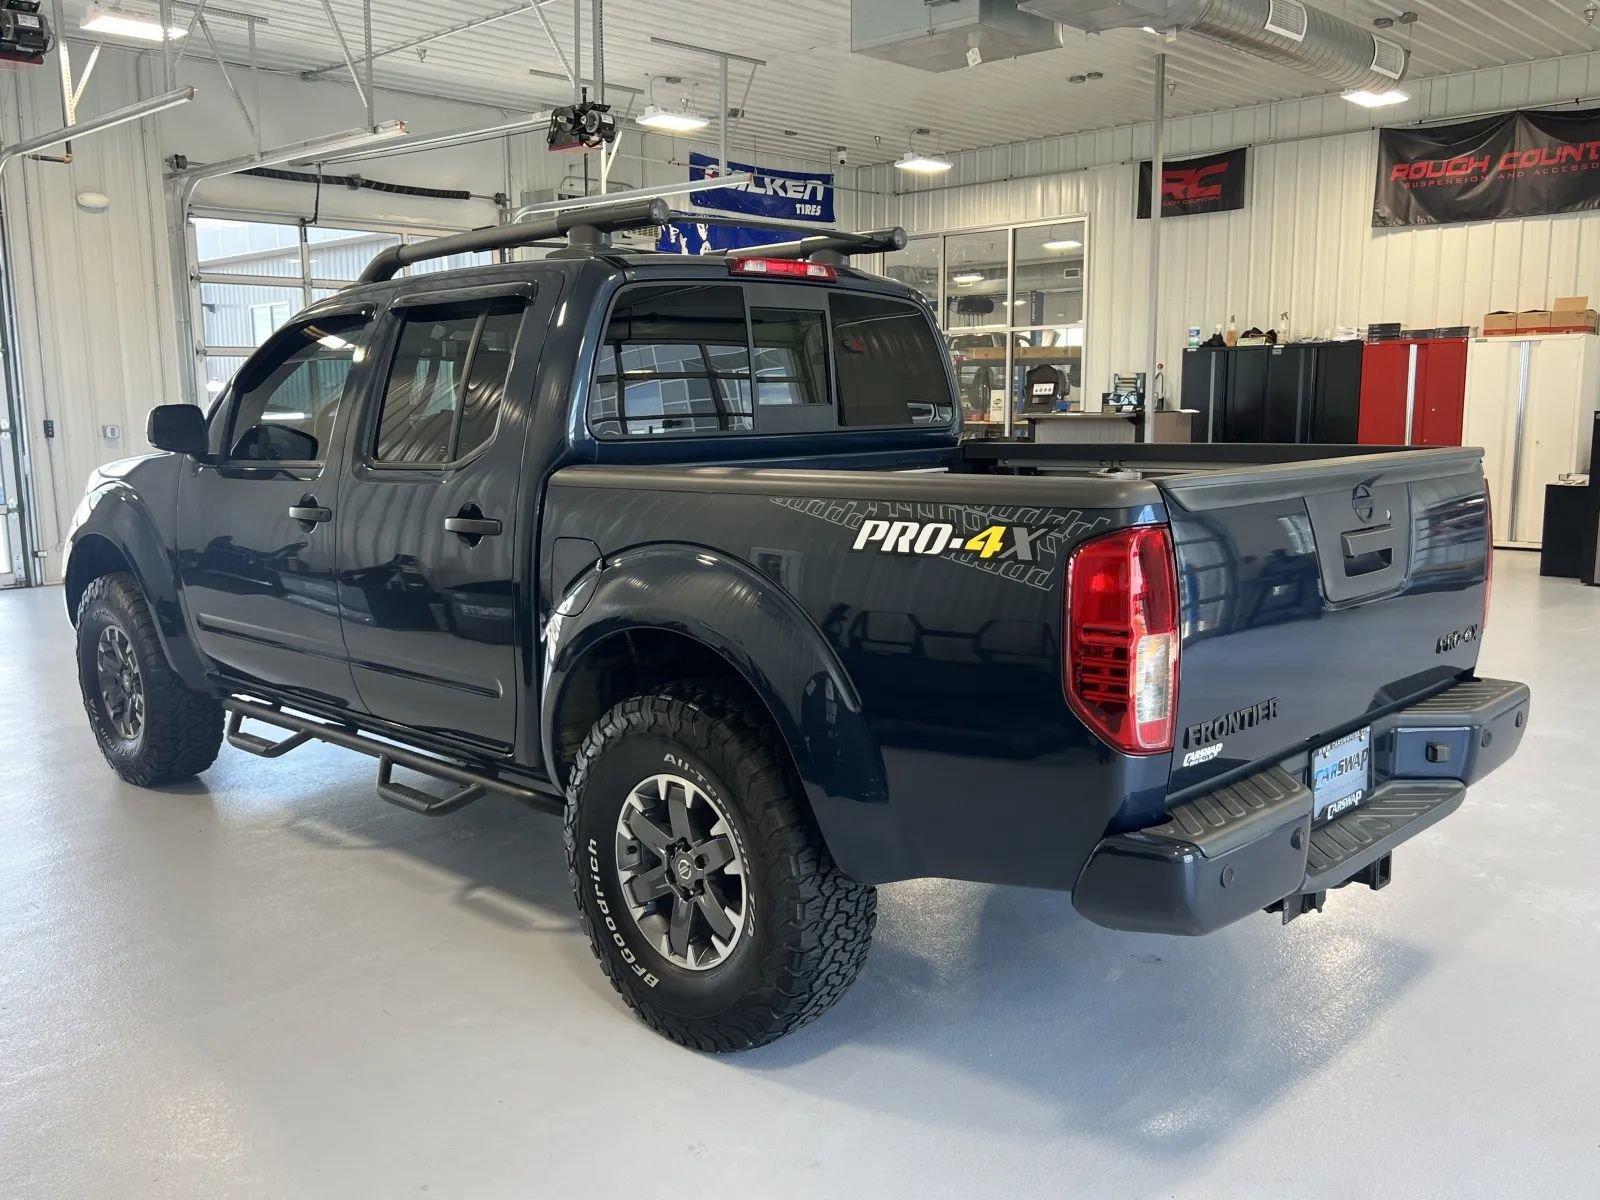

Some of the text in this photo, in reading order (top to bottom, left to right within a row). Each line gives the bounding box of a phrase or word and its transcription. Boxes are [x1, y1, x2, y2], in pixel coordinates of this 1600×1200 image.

[705, 164, 824, 201] LKEN
[1391, 154, 1491, 182] ROUGH
[1404, 175, 1489, 189] SUSPENSION
[1498, 171, 1525, 180] AND
[796, 203, 821, 216] TIRES
[853, 519, 1049, 561] PRO-4X
[1183, 696, 1280, 750] FRONTIER
[1183, 743, 1223, 767] CARSWAP
[1314, 747, 1369, 792] CARSWAP
[1327, 789, 1363, 820] CARSWAP
